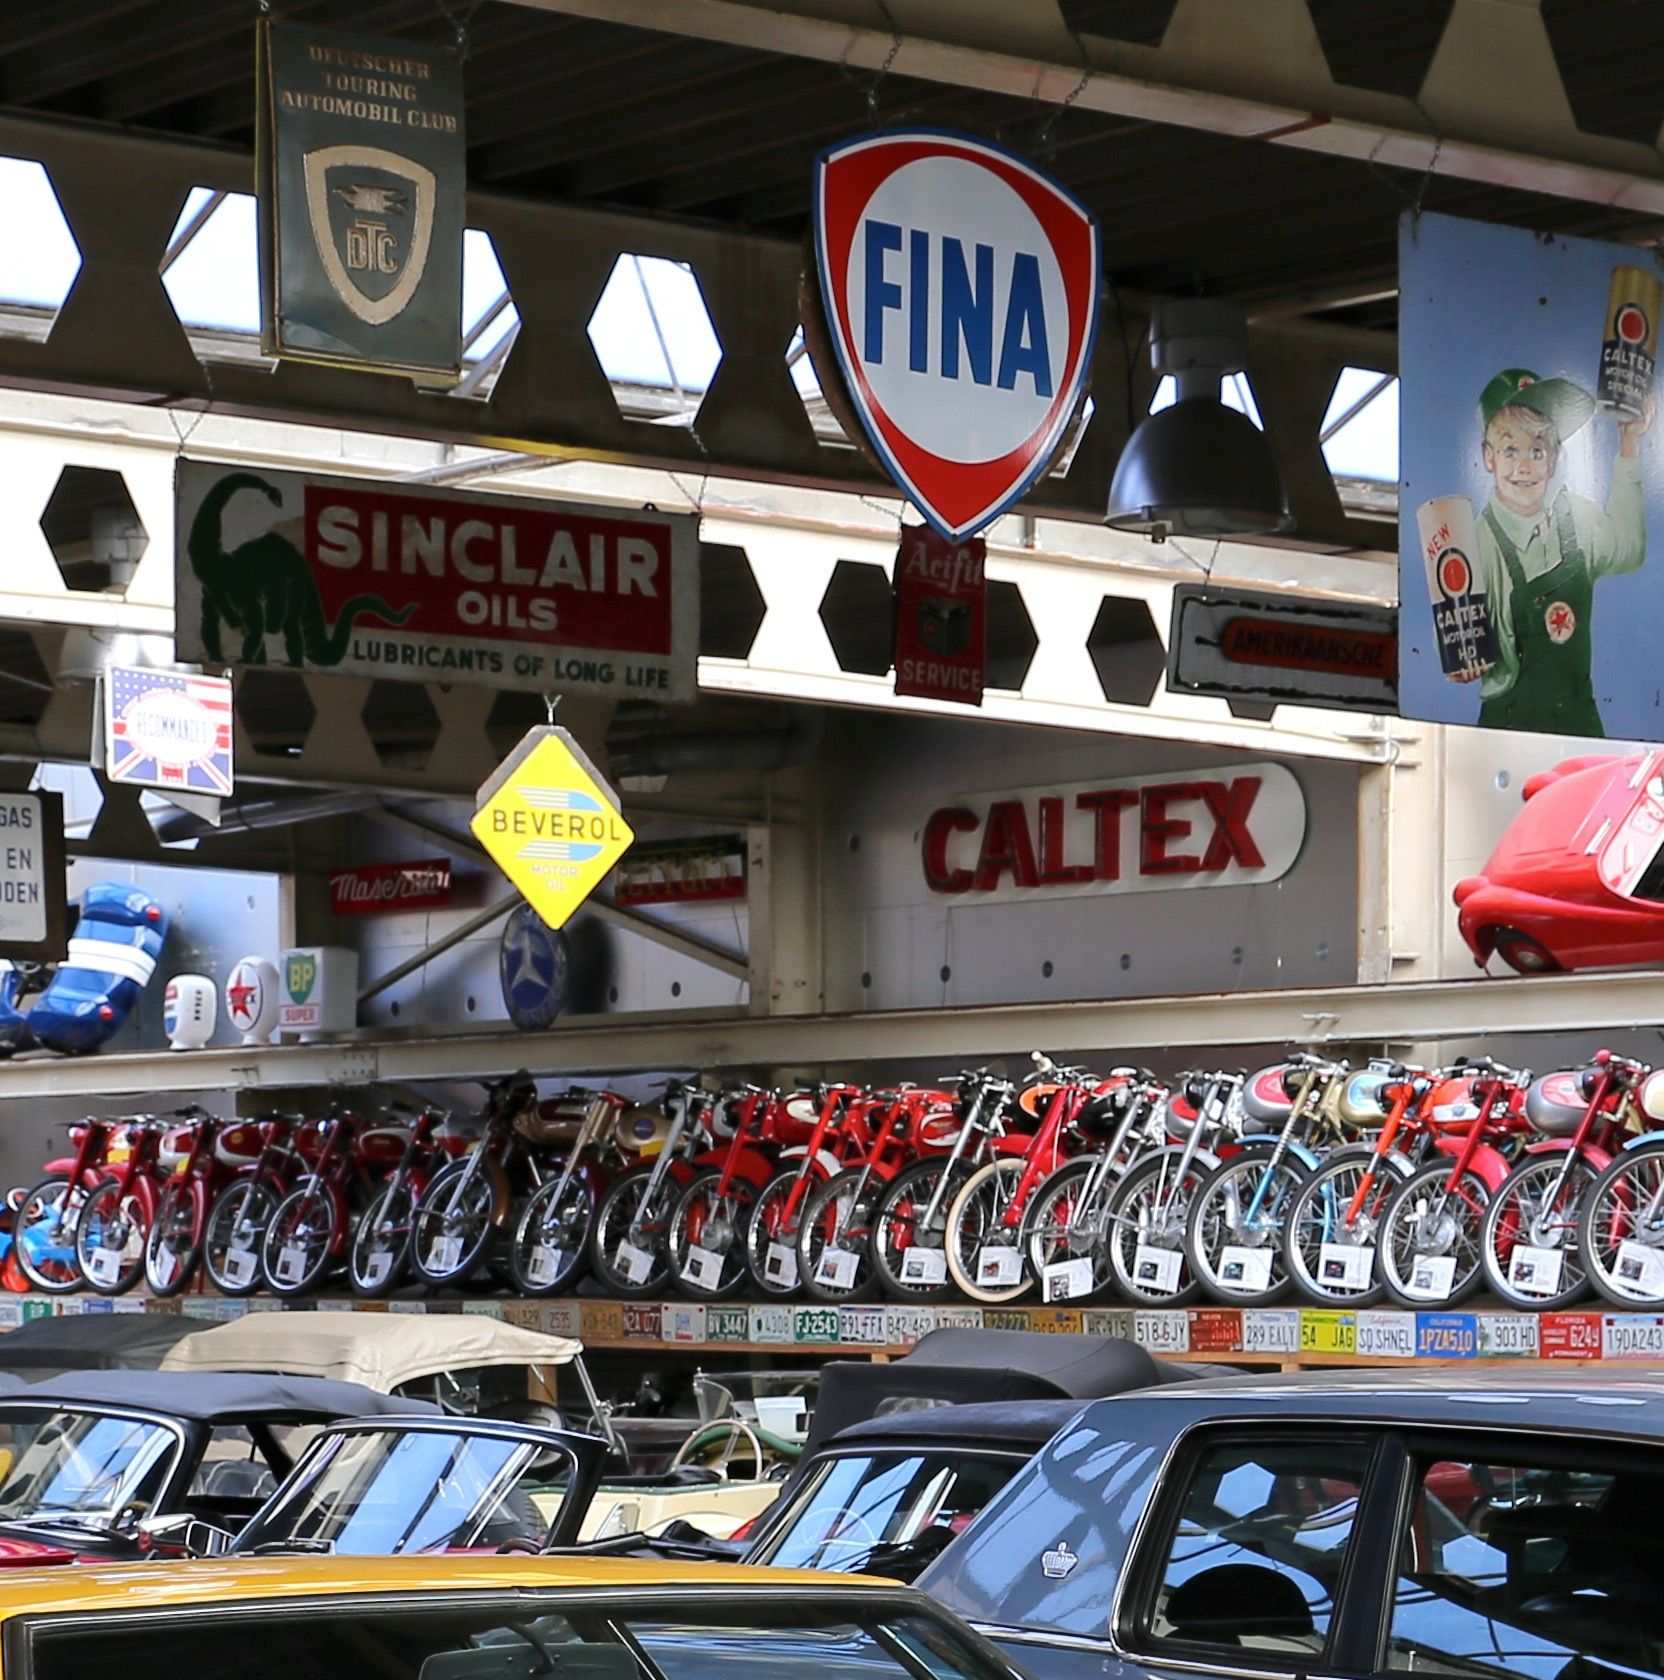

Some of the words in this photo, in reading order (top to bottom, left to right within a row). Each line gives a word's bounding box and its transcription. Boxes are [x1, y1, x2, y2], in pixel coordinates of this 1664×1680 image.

[309, 46, 430, 79] DEUTSCHER
[322, 72, 417, 101] TOURING
[281, 91, 402, 124] AUTOMOBIL
[407, 109, 457, 133] CLUB
[347, 219, 398, 274] DTC
[863, 219, 1053, 398] FINA
[1604, 348, 1653, 375] CALTEX
[317, 506, 660, 597] SINCLAIR
[1427, 524, 1451, 561] NEW
[457, 591, 558, 631] OILS
[1437, 603, 1486, 629] CALTEX
[354, 638, 503, 674] LUBRICANTS
[514, 655, 544, 678] OF
[555, 657, 615, 685] LONG
[625, 665, 669, 690] LIFE
[1458, 647, 1476, 661] HD
[903, 658, 981, 692] SERVICE
[493, 809, 621, 842] BEVEROL
[922, 776, 1266, 894] CALTEX
[7, 848, 32, 870] EN
[532, 864, 578, 878] MOTOR
[290, 963, 313, 992] BP
[286, 1007, 314, 1022] SUPER
[723, 1314, 747, 1333] 3447
[1137, 1321, 1158, 1341] 518
[1162, 1322, 1185, 1340] GJY
[1246, 1326, 1265, 1345] 289
[1269, 1326, 1295, 1346] EALY
[1302, 1326, 1316, 1346] 54
[1332, 1327, 1353, 1347] JAG
[1496, 1326, 1517, 1347] 903
[1520, 1327, 1536, 1348] HD
[1376, 1328, 1412, 1351] SHNEL
[1419, 1328, 1473, 1352] 1PZA510
